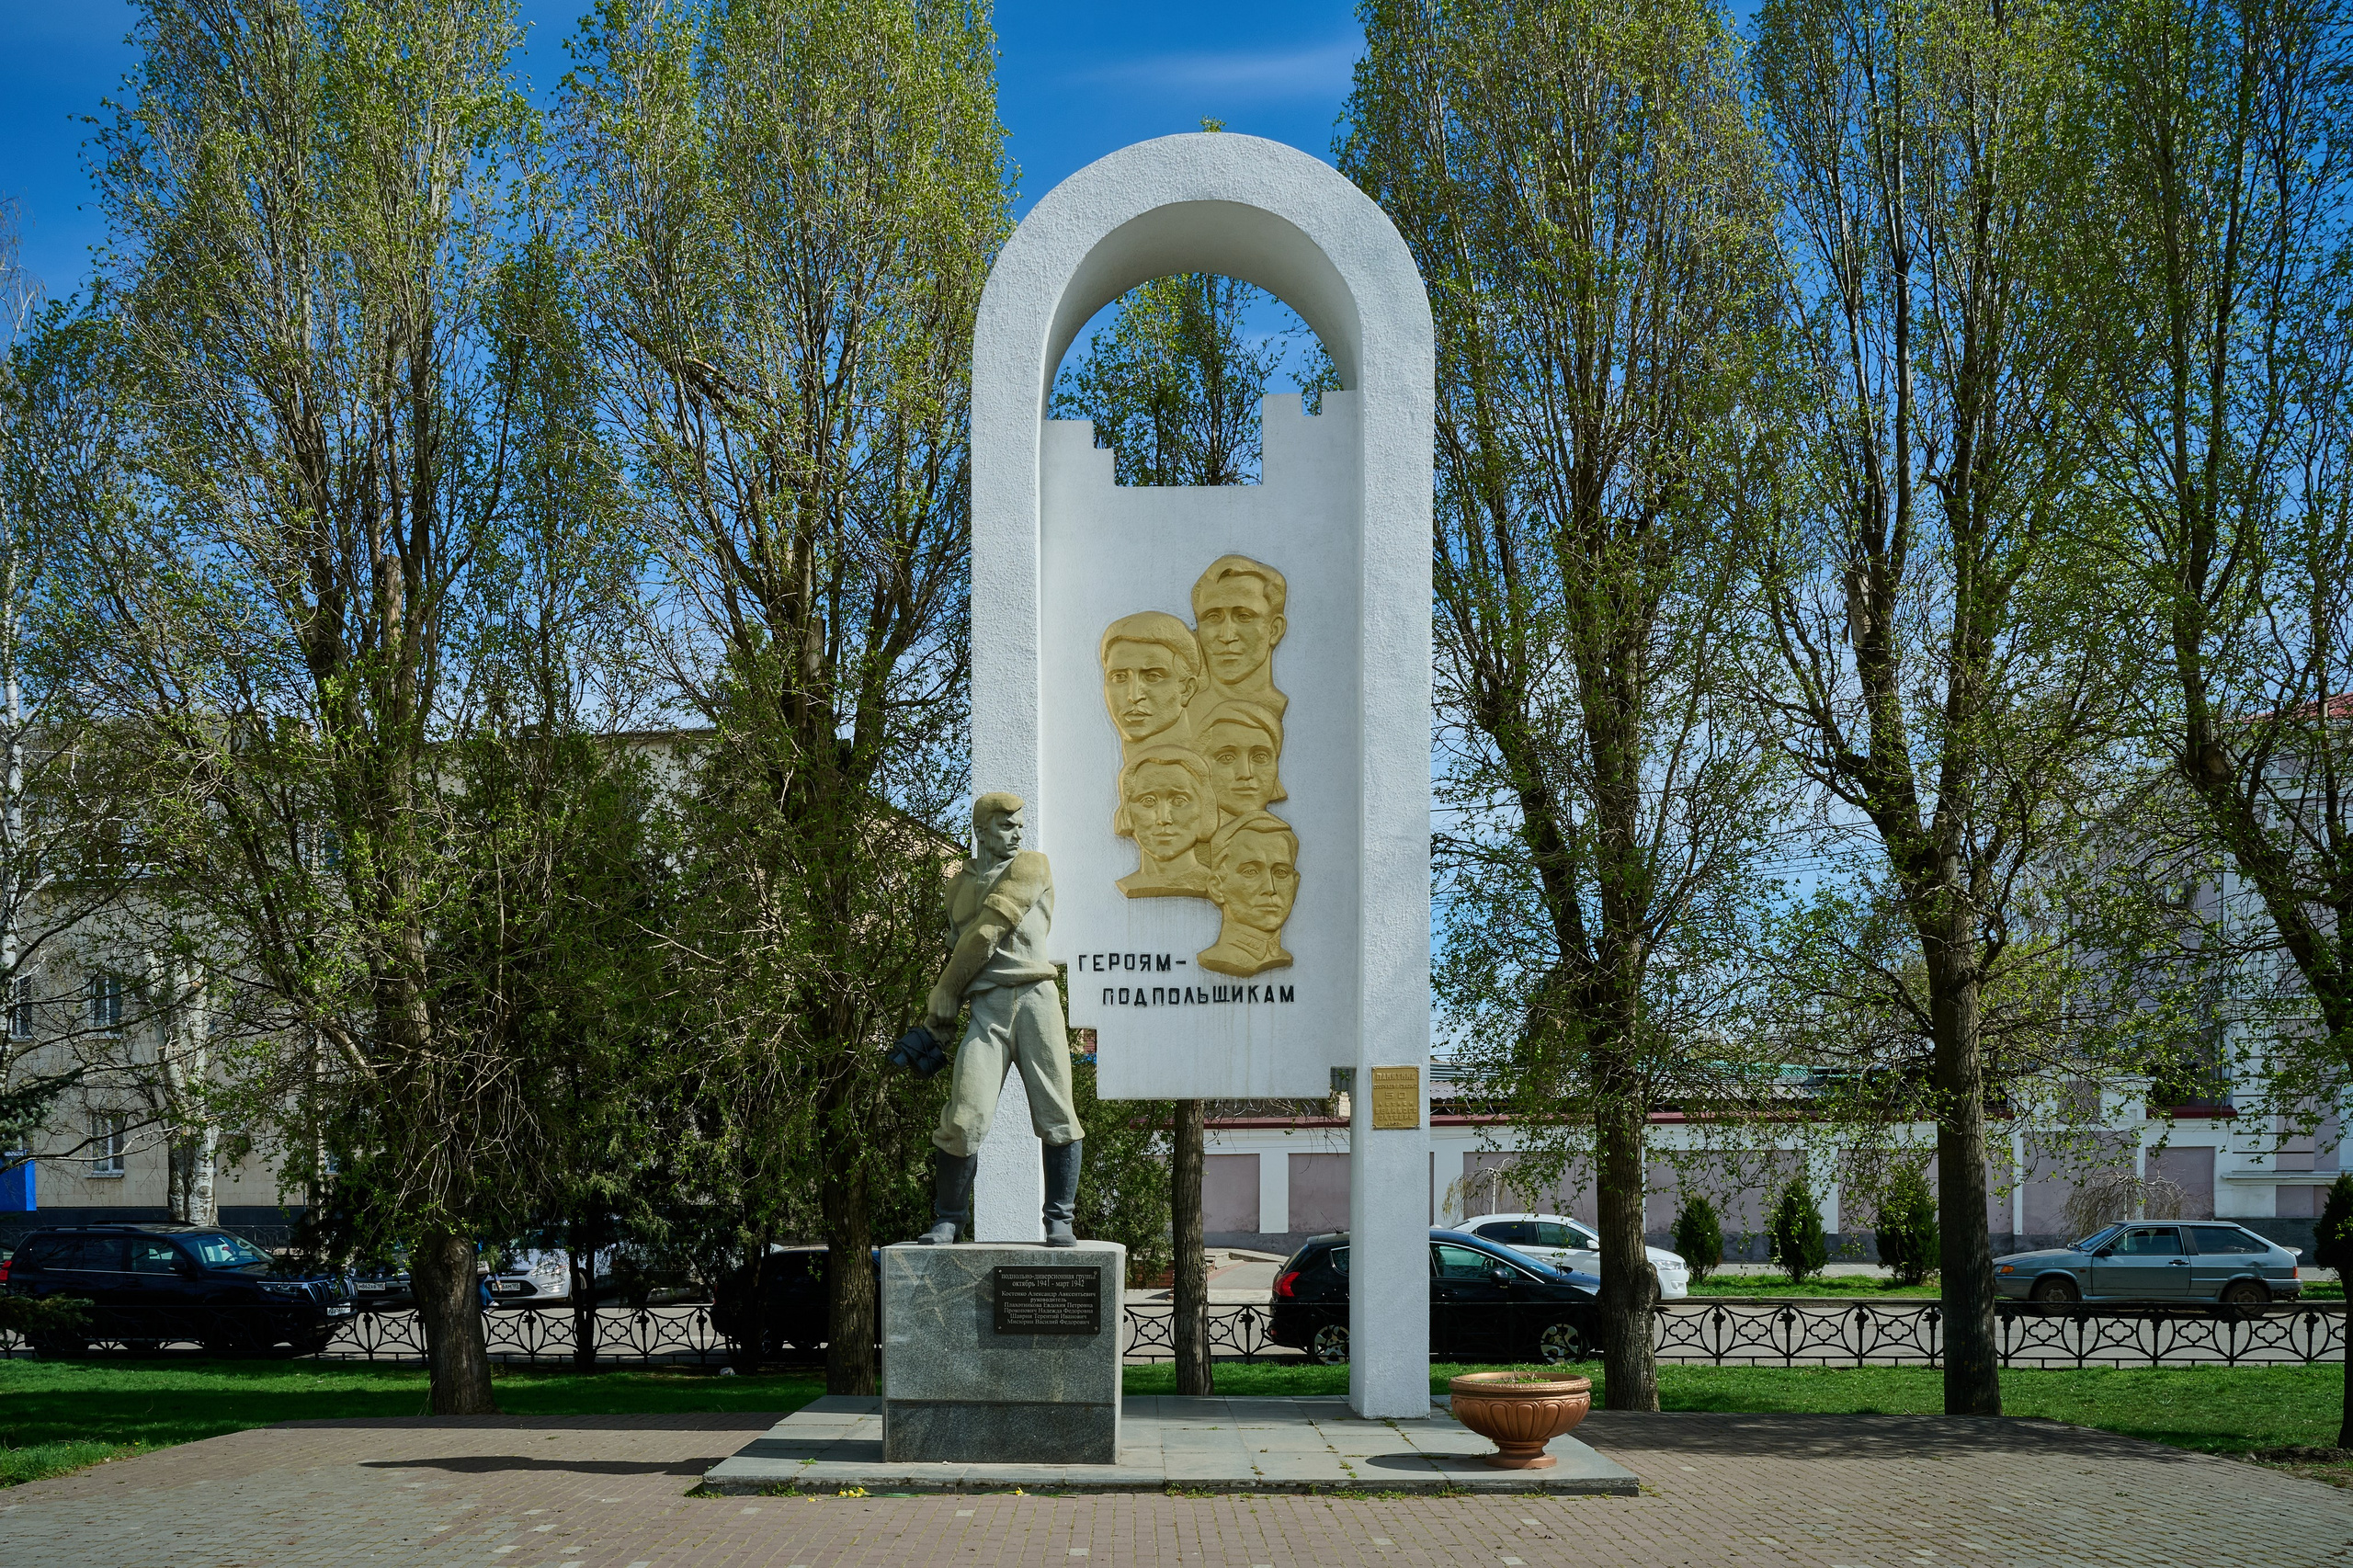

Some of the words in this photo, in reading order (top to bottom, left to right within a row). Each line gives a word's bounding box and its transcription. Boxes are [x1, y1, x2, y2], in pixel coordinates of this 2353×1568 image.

[1078, 952, 1187, 972] ГЕРОЯМ-
[1102, 985, 1295, 1006] ПОДПОЛЬЩИКАМ
[1376, 1073, 1415, 1081] ПАМЯТНИК
[1385, 1091, 1407, 1099] 50
[1012, 1279, 1035, 1288] октябрь
